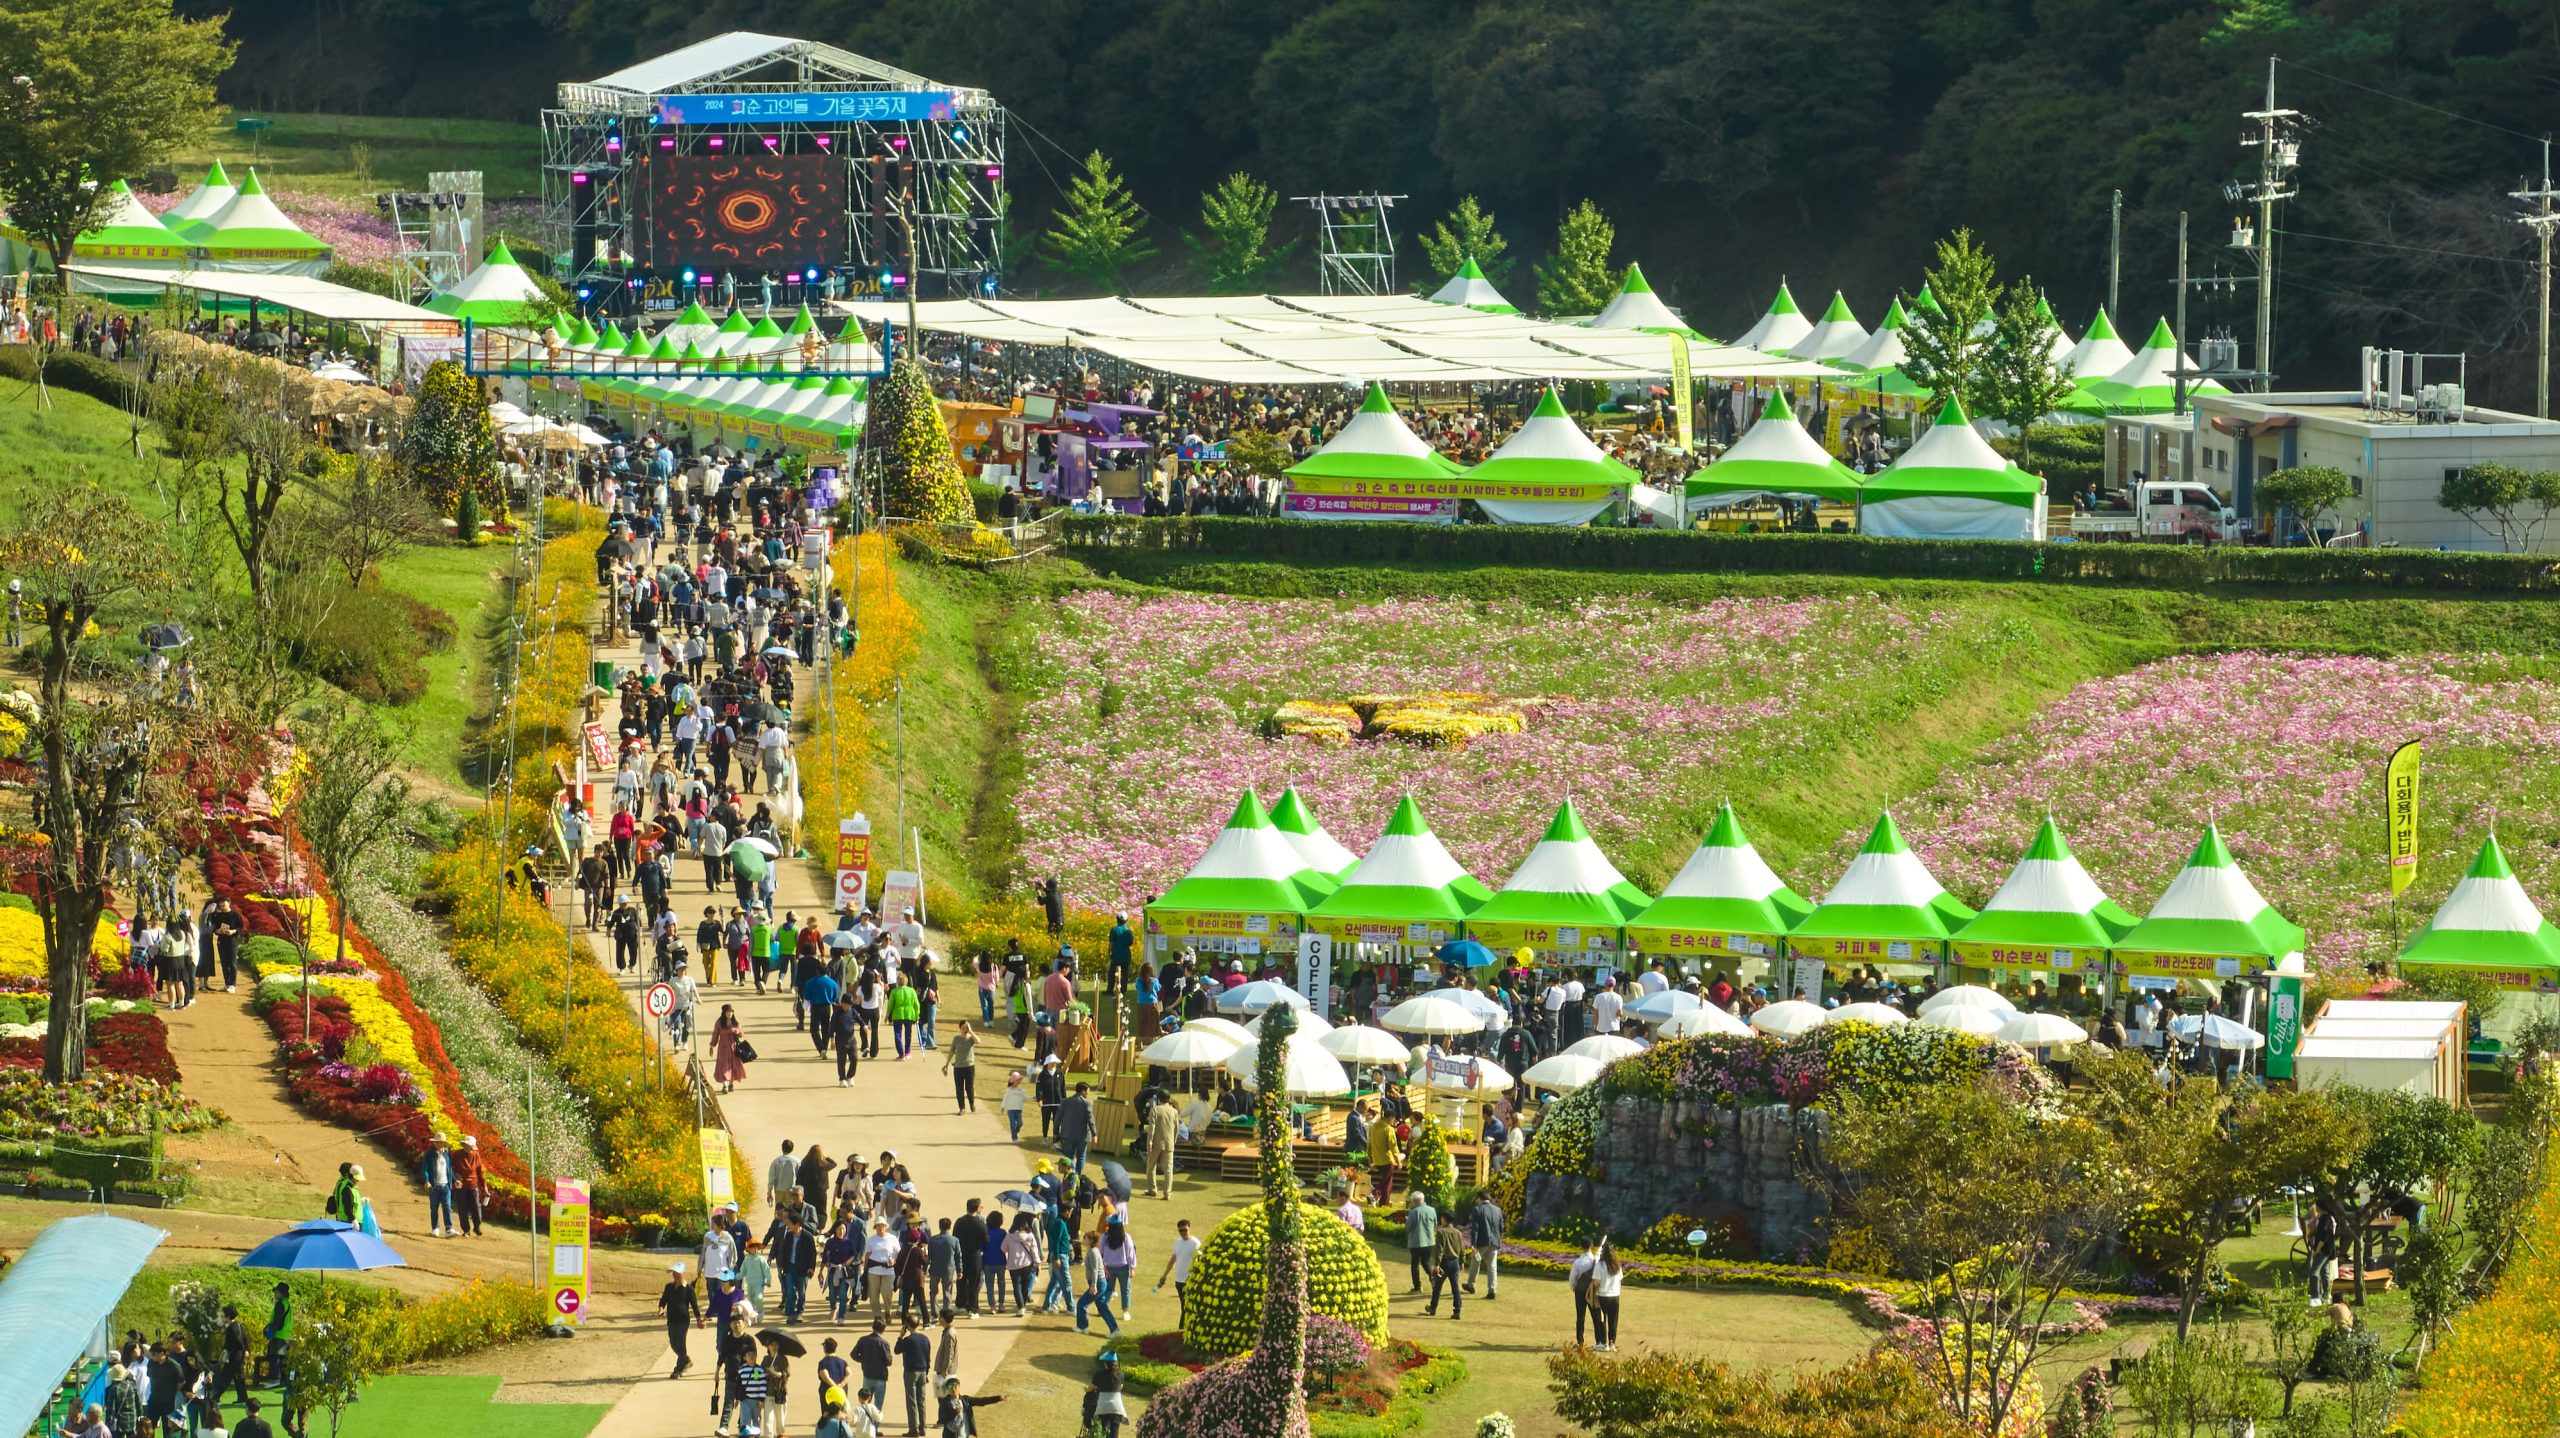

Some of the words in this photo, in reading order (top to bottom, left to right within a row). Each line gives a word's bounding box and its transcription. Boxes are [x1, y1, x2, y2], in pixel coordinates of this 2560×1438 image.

[704, 100, 725, 110] 2024
[731, 98, 762, 116] 화순
[763, 97, 809, 116] 고인돌
[2395, 775, 2413, 827] 다회용기
[841, 837, 868, 852] 차량
[2396, 829, 2413, 856] 반납
[840, 851, 866, 867] 출구
[1669, 933, 1724, 949] 은숙식품
[2153, 955, 2171, 968] 카페
[1308, 940, 1322, 1015] COFFE
[653, 992, 668, 1009] 30
